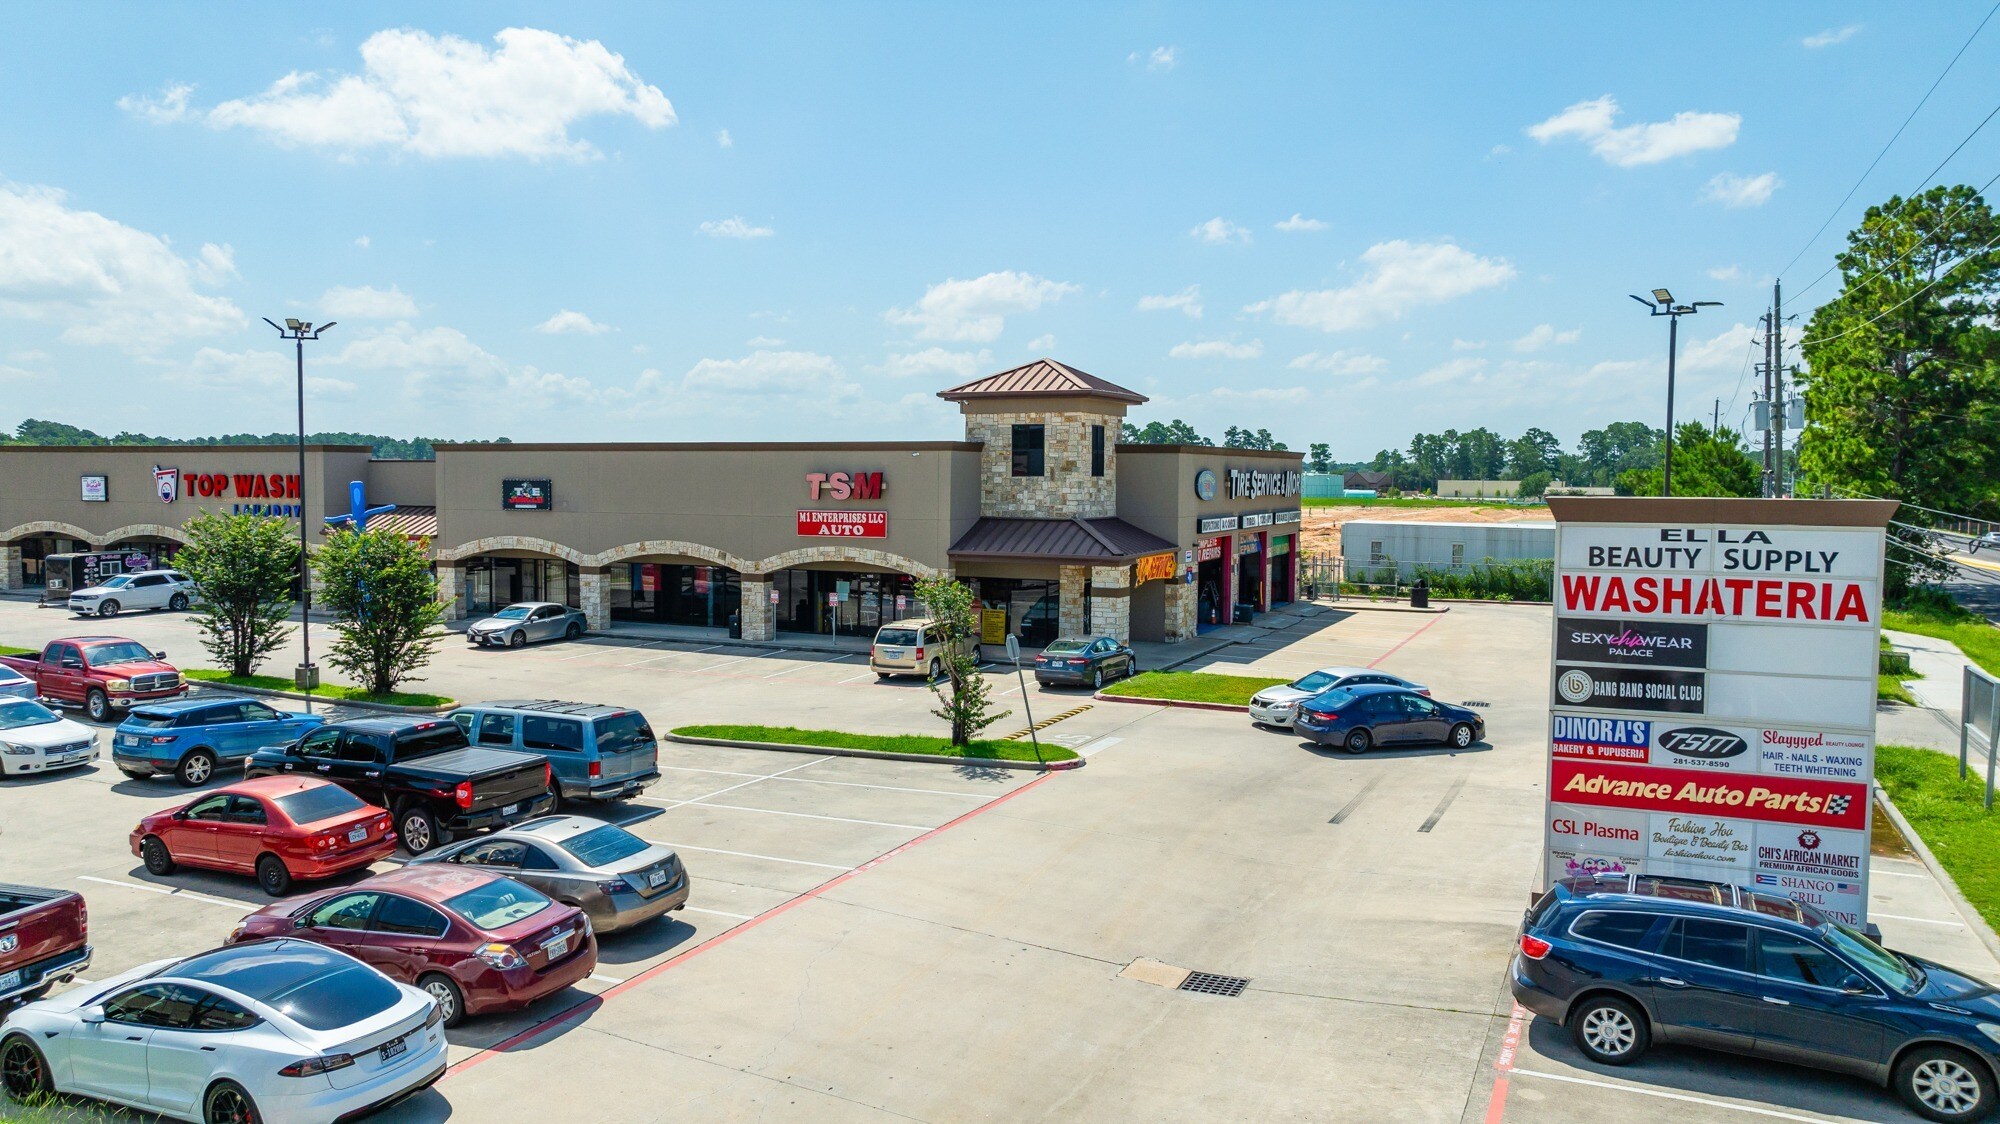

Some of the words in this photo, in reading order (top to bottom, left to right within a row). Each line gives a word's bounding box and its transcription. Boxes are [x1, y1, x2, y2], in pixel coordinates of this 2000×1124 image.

[184, 474, 228, 497] TOP
[233, 474, 300, 498] WASH
[806, 472, 882, 500] TSM
[1229, 469, 1250, 499] TIRE
[1250, 470, 1280, 499] SERVICE
[1281, 474, 1285, 494] &
[1285, 471, 1301, 497] MOR
[800, 512, 811, 522] M1
[812, 512, 866, 523] ENTERPRISES
[868, 514, 884, 523] LLC
[818, 525, 864, 535] AUTO
[1660, 529, 1772, 544] ELLA
[1588, 546, 1702, 569] BEAUTY
[1723, 549, 1840, 573] SUPPLY
[1562, 575, 1869, 622] WASHATERIA
[1571, 632, 1614, 645] SEXY
[1639, 636, 1692, 649] WEAR
[1609, 647, 1653, 657] PALACE
[1594, 681, 1617, 697] BANG
[1620, 682, 1643, 698] BANG
[1645, 683, 1677, 699] SOCIAL
[1680, 685, 1702, 701] CLUB
[1554, 716, 1645, 744] DINORA'S
[1762, 729, 1823, 749] Slayyyed
[1552, 743, 1584, 755] BAKERY
[1587, 746, 1594, 755] &
[1598, 747, 1644, 759] PUPUSERIA
[1665, 732, 1741, 753] TSM
[1673, 758, 1730, 768] 281-537-8590
[1762, 751, 1784, 760] HAIR
[1791, 753, 1818, 763] NAILS
[1825, 755, 1863, 766] WAXING
[1774, 763, 1803, 773] TEETH
[1805, 765, 1857, 777] WHITENING
[1564, 773, 1672, 799] Advance
[1674, 782, 1745, 806] Auto
[1746, 787, 1823, 813] Parts
[1552, 818, 1579, 834] CSL
[1584, 822, 1639, 840] Plasma
[1668, 818, 1706, 834] Fashion
[1652, 832, 1688, 846] Boutique
[1700, 837, 1729, 851] Beauty
[1731, 840, 1749, 851] Bar
[1758, 847, 1781, 860] CHI'S
[1783, 849, 1821, 864] AFRICAN
[1823, 853, 1860, 868] MARKET
[1759, 861, 1794, 871] PREMIUM
[1796, 865, 1829, 875] AFRICAN
[1831, 868, 1859, 878] GOODS
[1781, 876, 1834, 892] SHANGO
[1789, 891, 1825, 905] GRILL
